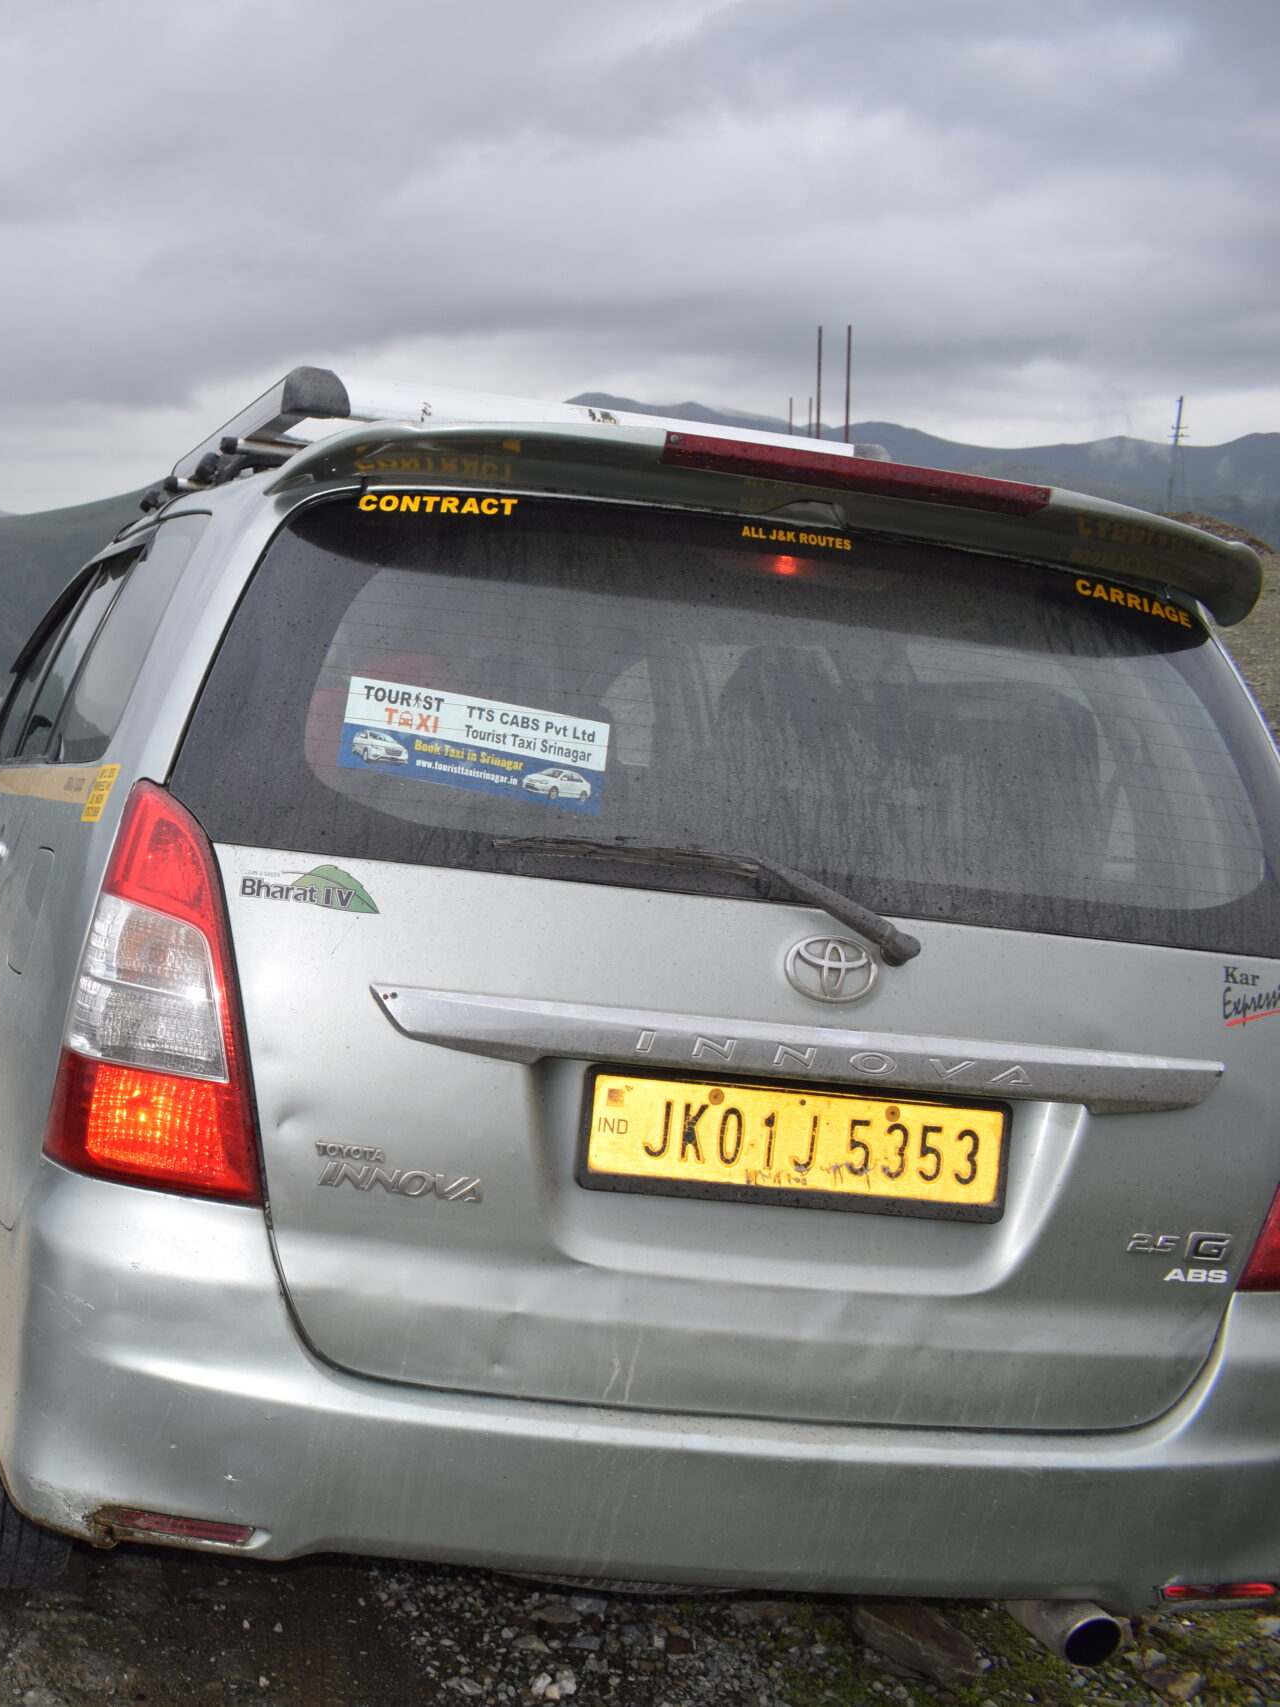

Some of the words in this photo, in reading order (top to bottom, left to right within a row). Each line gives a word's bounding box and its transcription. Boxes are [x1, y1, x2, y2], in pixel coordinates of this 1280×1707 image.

[359, 494, 518, 515] CONTRACT
[742, 525, 766, 539] ALL
[769, 529, 796, 543] J&K
[799, 532, 852, 551] ROUTES
[1075, 578, 1192, 629] CARRIAGE
[467, 705, 495, 722] TTS
[500, 712, 540, 732] CABS
[544, 721, 568, 738] Pvt
[572, 727, 596, 743] Ltd
[414, 739, 441, 756] Book
[444, 744, 465, 759] Taxi
[467, 748, 477, 762] in
[480, 752, 525, 771] Srinagar
[465, 724, 507, 746] Tourist
[511, 734, 537, 751] Taxi
[540, 739, 592, 763] Srinagar
[415, 759, 519, 786] www.touristtaxisrinagar.in
[241, 877, 318, 904] Bharat
[323, 887, 355, 909] IV
[1223, 966, 1260, 986] Kar
[635, 1029, 1033, 1087] INNOVA
[597, 1115, 629, 1135] IND
[316, 1141, 385, 1162] TOYOTA
[318, 1161, 482, 1203] INNOVA
[1163, 1268, 1228, 1284] ABS
